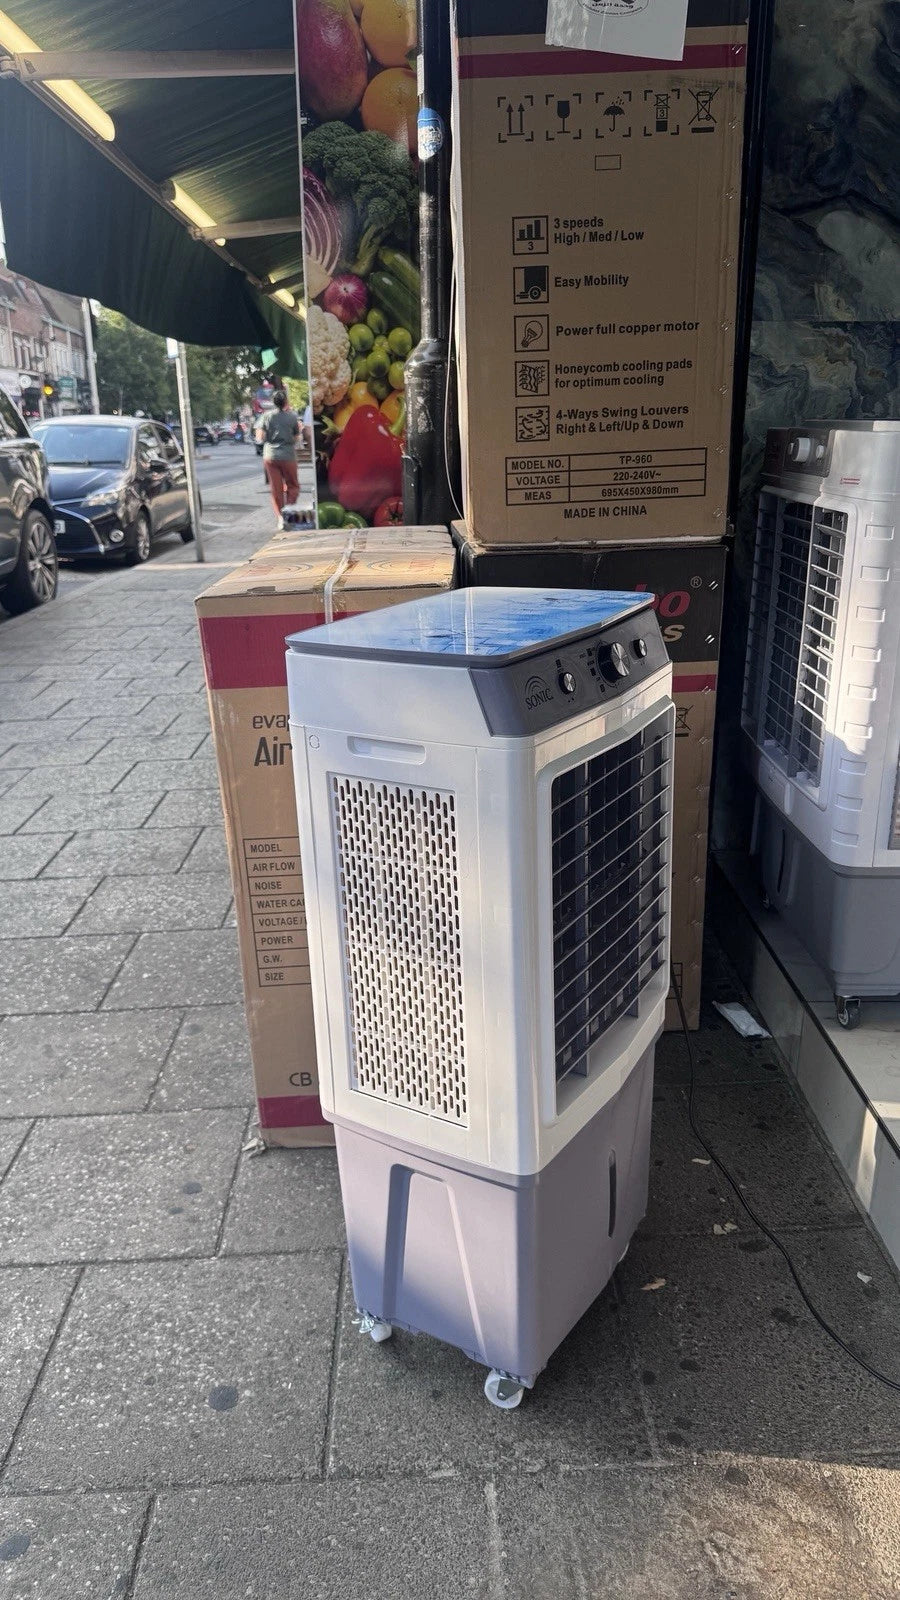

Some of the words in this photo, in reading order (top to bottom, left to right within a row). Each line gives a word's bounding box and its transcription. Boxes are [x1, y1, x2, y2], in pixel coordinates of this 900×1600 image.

[553, 218, 561, 229] 3
[562, 216, 604, 230] speeds
[554, 232, 580, 246] High
[588, 231, 612, 242] Med
[621, 230, 645, 241] Low
[527, 241, 534, 251] 3
[554, 276, 582, 289] Easy
[584, 274, 629, 287] Mobility
[556, 325, 593, 336] Power
[596, 324, 616, 335] full
[618, 322, 661, 335] copper
[663, 320, 700, 332] motor
[555, 362, 620, 376] Honeycomb
[622, 360, 663, 372] cooling
[665, 358, 693, 370] pads
[555, 378, 571, 388] for
[573, 376, 621, 389] optimum
[623, 374, 665, 387] cooling
[556, 408, 599, 421] 4-Ways
[601, 406, 638, 419] Swing
[641, 405, 689, 416] Louvers
[556, 423, 586, 436] Right
[588, 422, 597, 432] &
[599, 420, 640, 433] Left/Up
[642, 420, 651, 430] &
[653, 418, 684, 429] Down
[511, 460, 547, 471] MODEL
[548, 458, 565, 469] NO.
[619, 454, 653, 465] TP-960
[516, 474, 561, 486] VOLTAGE
[524, 491, 552, 501] MEAS
[601, 486, 679, 498] 695X450X980mm
[563, 508, 596, 519] MADE
[598, 507, 610, 517] IN
[612, 506, 648, 516] CHINA
[525, 688, 554, 710] SONIC
[254, 736, 293, 767] Air
[250, 843, 282, 853] MODEL
[252, 863, 269, 872] AIR
[270, 861, 296, 871] FLOW
[254, 881, 282, 890] NOISE
[256, 899, 288, 909] WATER
[289, 898, 305, 907] CA
[260, 936, 294, 946] POWER
[263, 954, 283, 964] G.W.
[264, 972, 285, 982] SIZE
